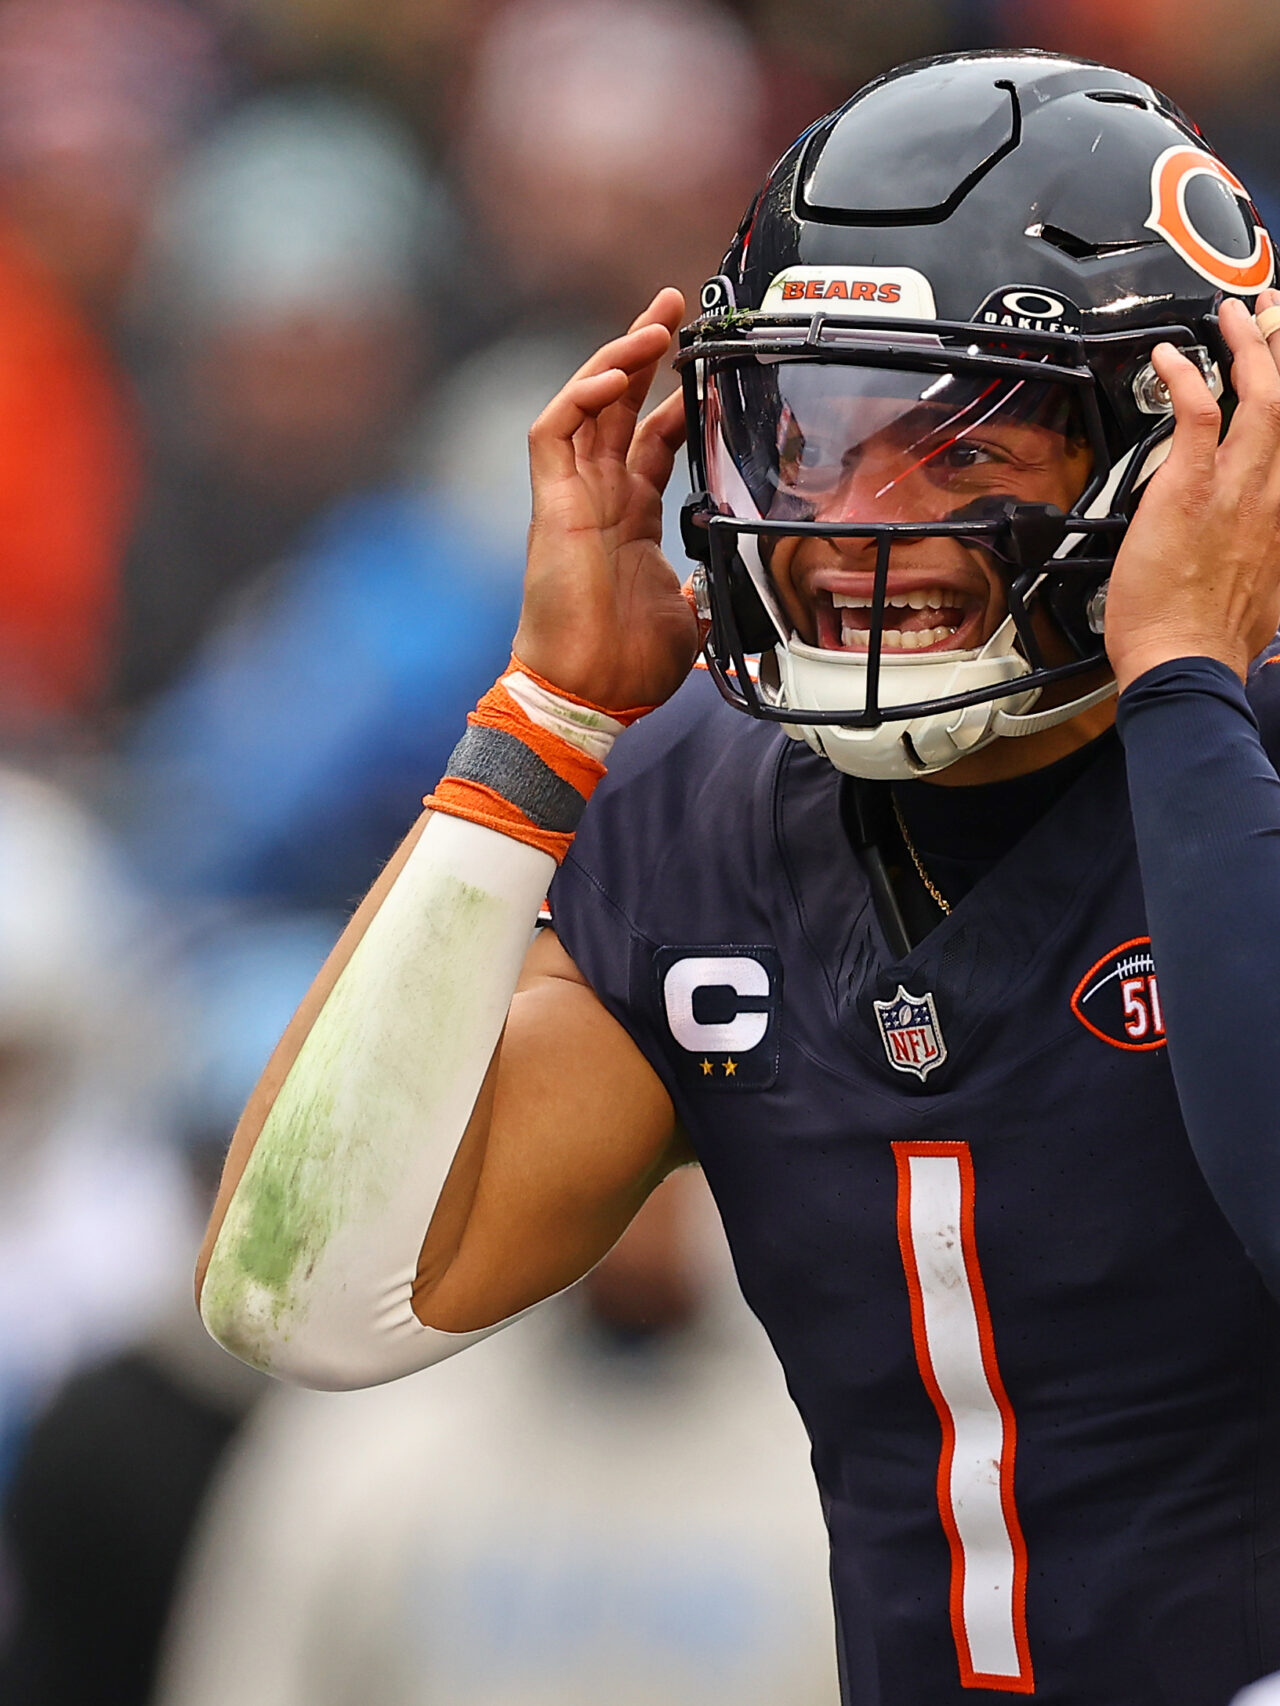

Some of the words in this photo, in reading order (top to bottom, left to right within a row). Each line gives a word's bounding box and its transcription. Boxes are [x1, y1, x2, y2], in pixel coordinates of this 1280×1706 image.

[782, 280, 901, 303] BEARS
[984, 311, 1077, 334] OAKLEY
[664, 957, 769, 1052] C
[890, 1029, 936, 1063] NFL
[891, 1141, 1035, 1693] 1
